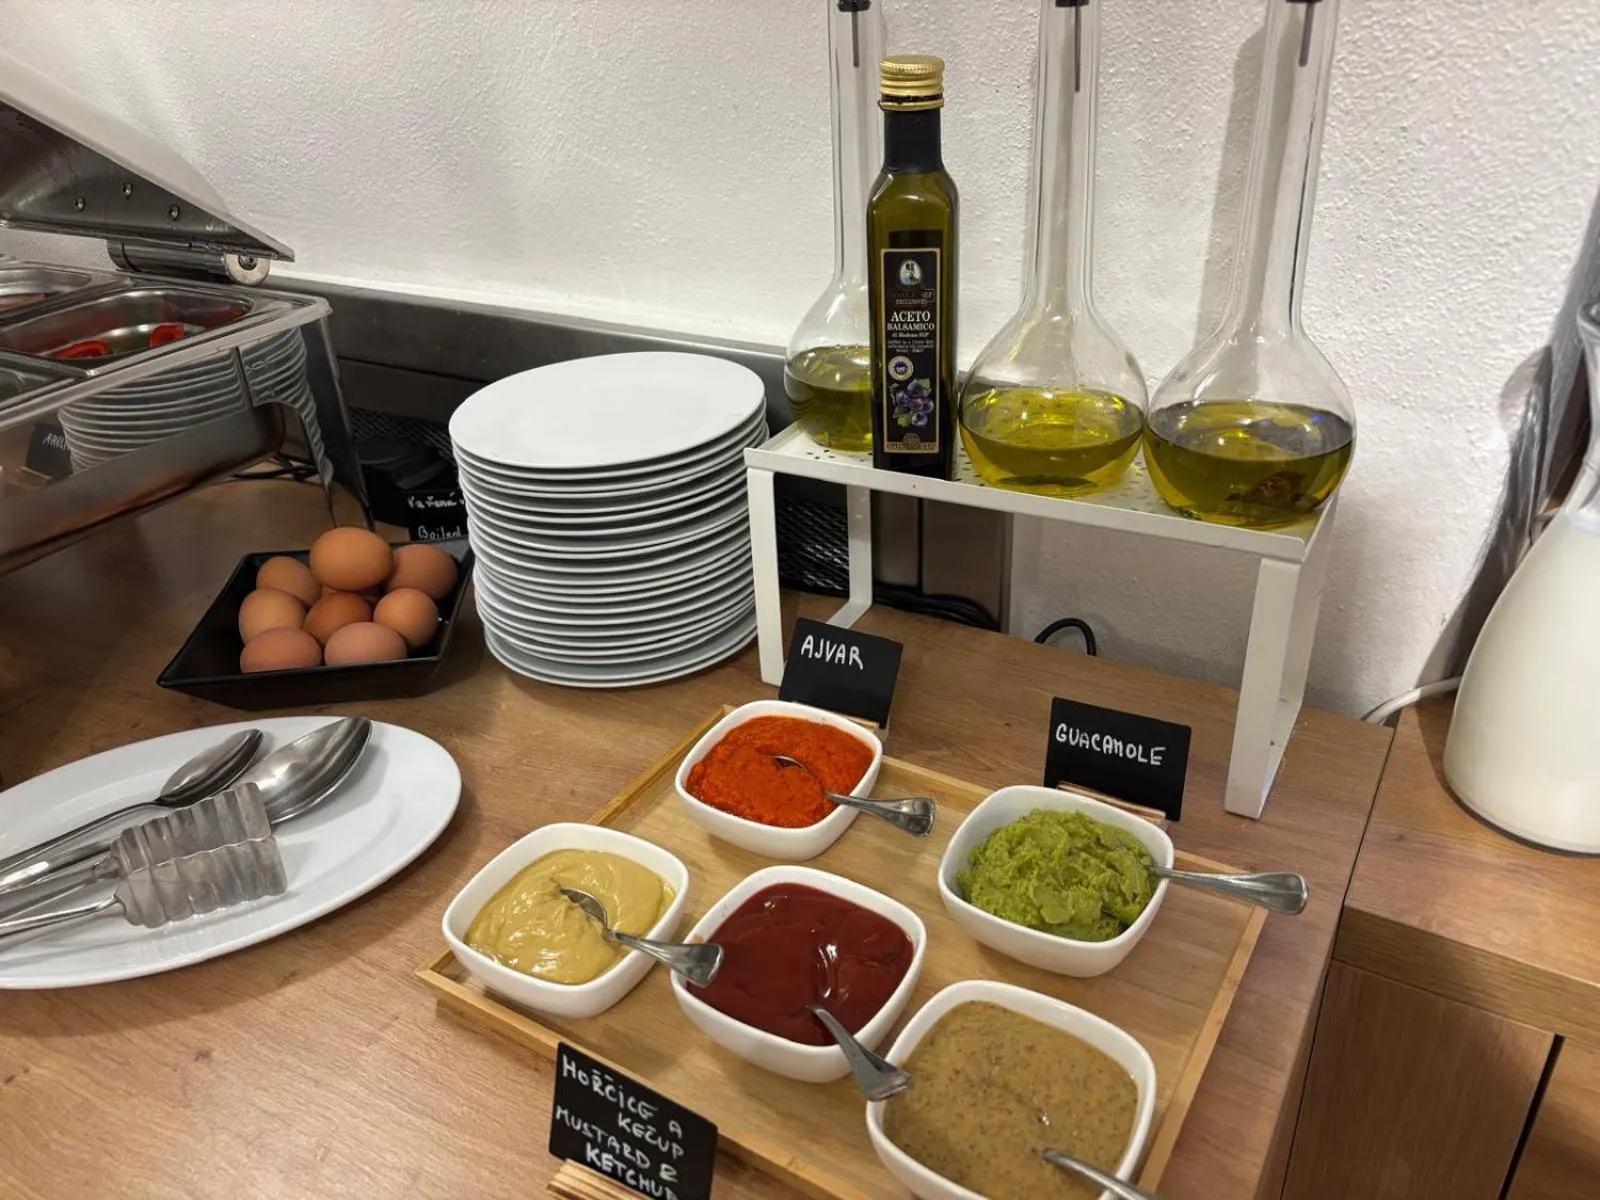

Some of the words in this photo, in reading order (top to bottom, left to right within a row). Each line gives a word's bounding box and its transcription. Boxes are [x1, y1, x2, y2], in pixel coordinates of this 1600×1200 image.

[887, 322, 935, 331] BALSAMICO
[891, 310, 931, 322] ACETO
[800, 634, 864, 671] AJVAR
[1055, 722, 1167, 766] GUACAMOLE
[555, 1105, 651, 1169] MUSTARD
[668, 1120, 683, 1140] A
